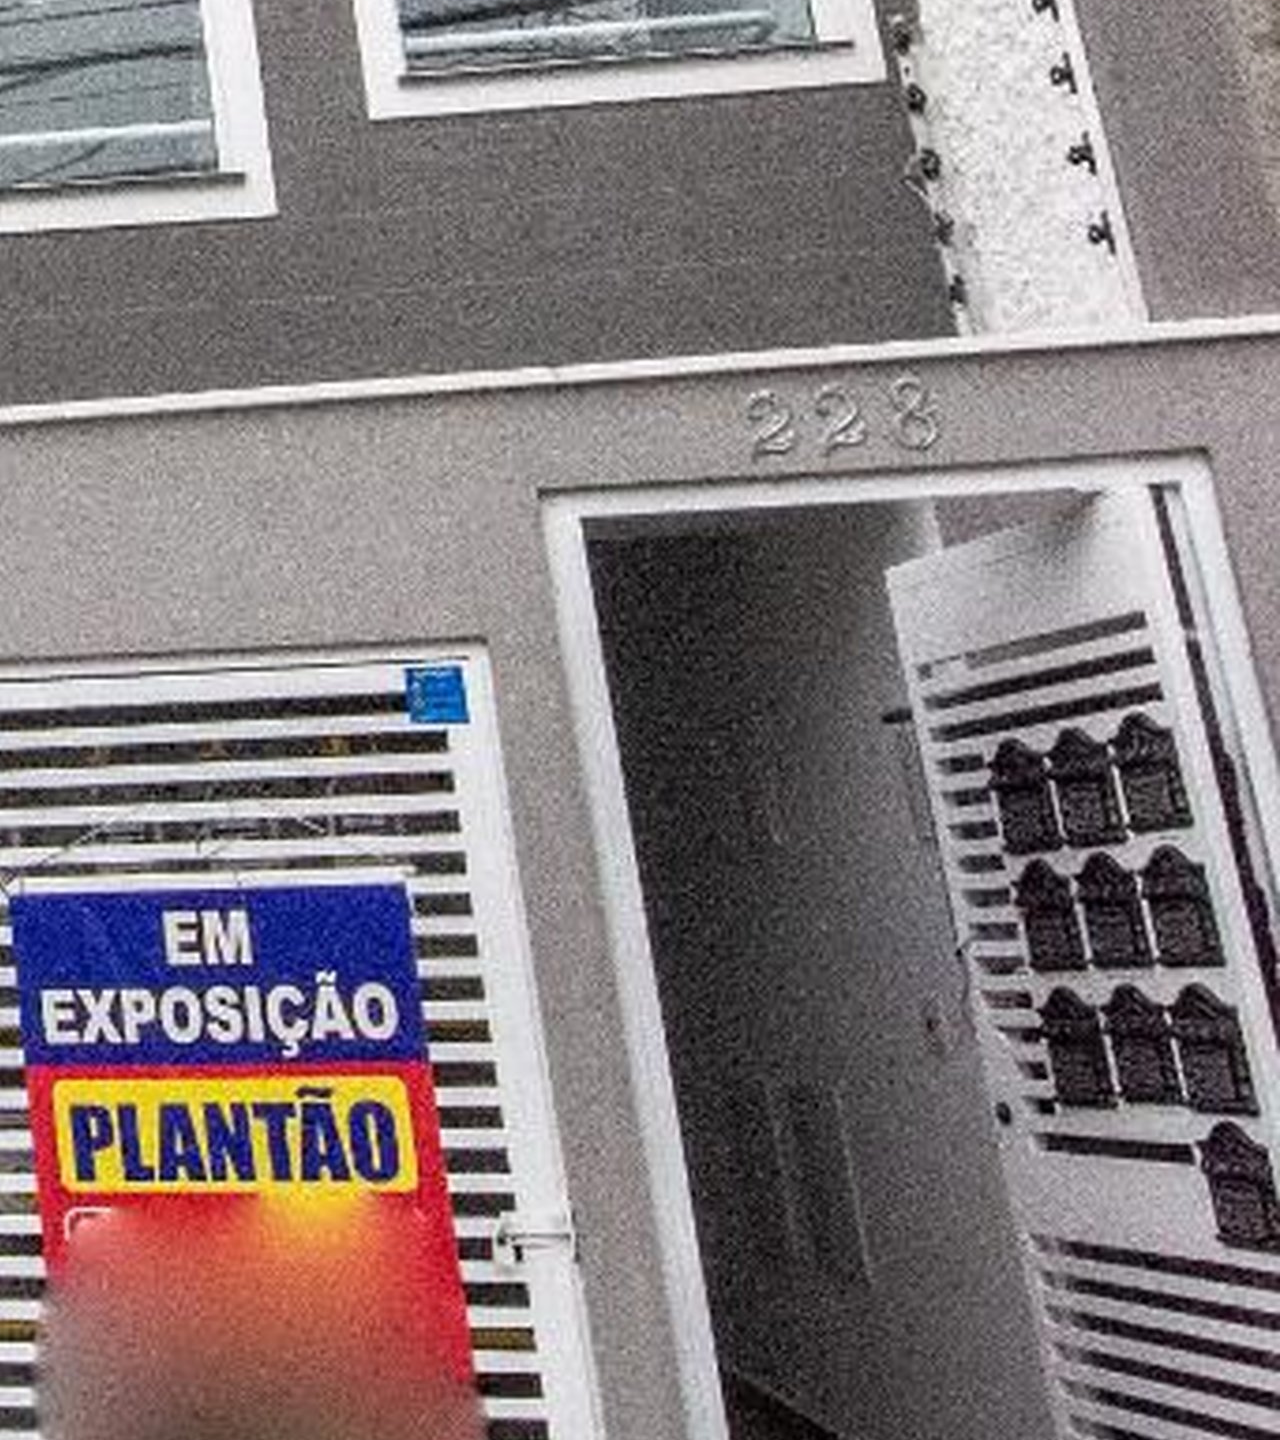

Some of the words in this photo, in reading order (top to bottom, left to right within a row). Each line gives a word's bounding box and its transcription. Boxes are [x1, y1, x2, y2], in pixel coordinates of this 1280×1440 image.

[747, 376, 941, 462] 228
[161, 910, 254, 967] EM
[41, 972, 400, 1058] EXPOSIÇÃO
[69, 1086, 400, 1184] PLANTÃO
